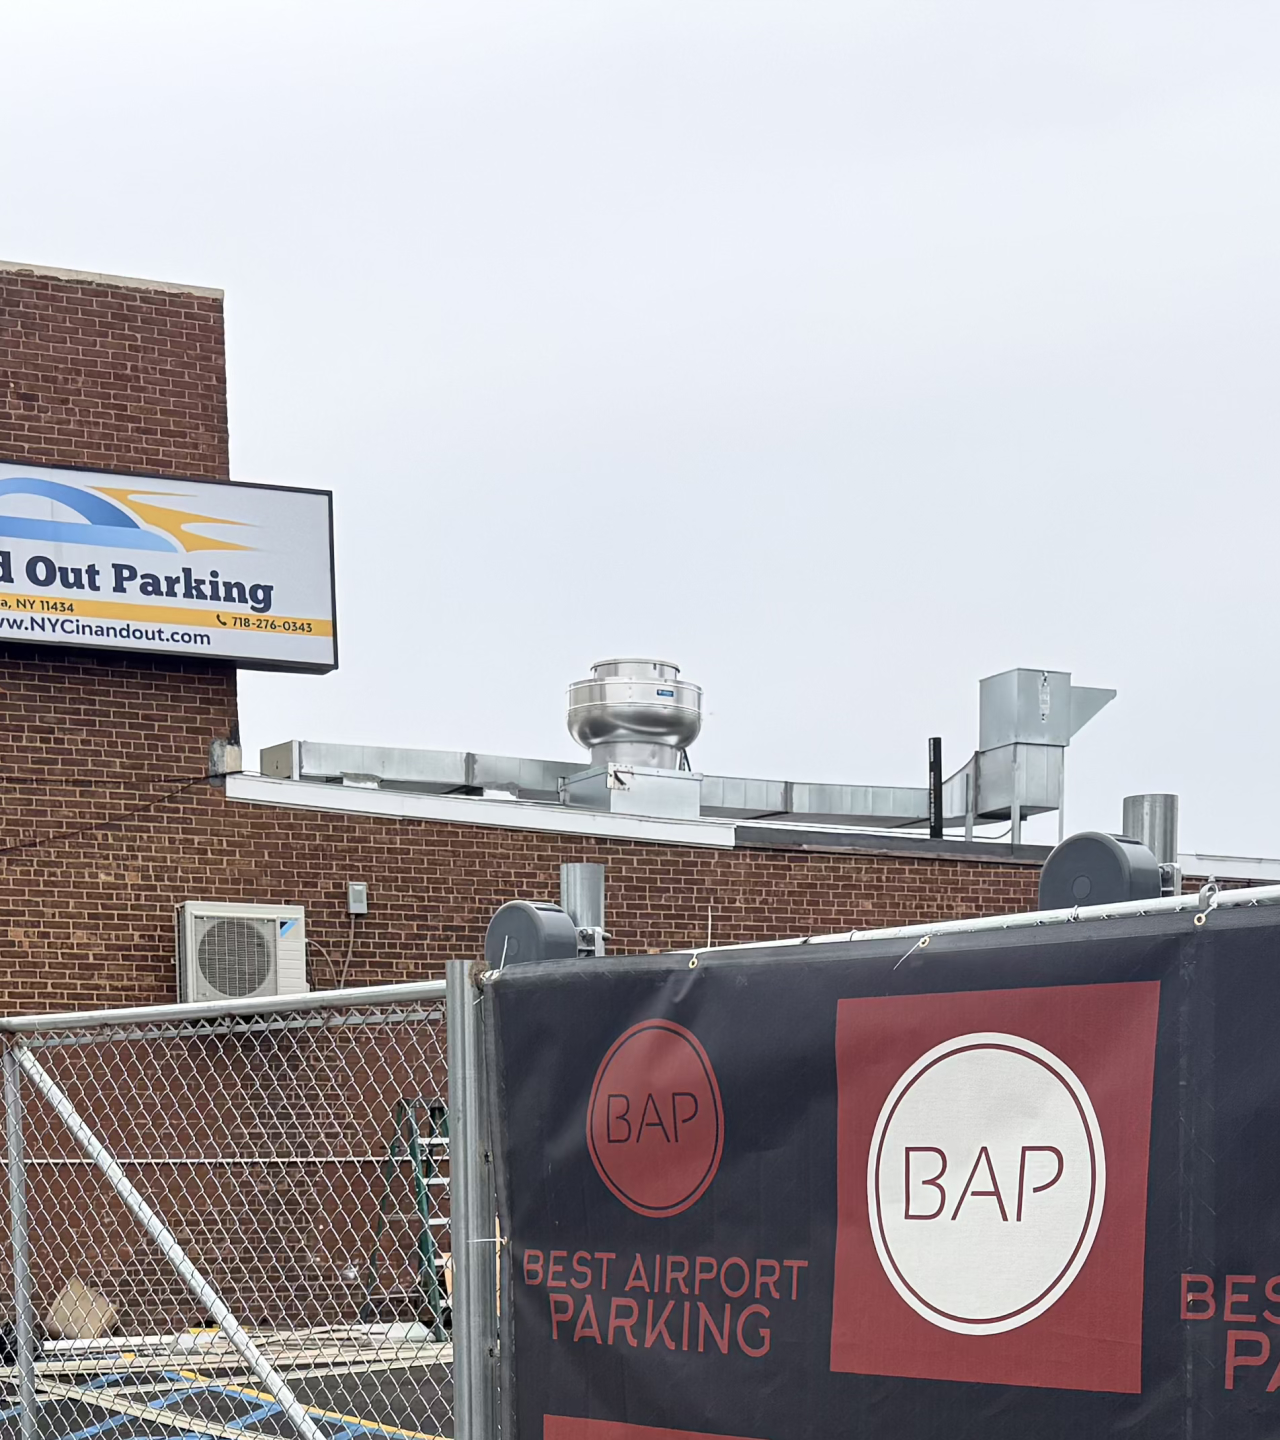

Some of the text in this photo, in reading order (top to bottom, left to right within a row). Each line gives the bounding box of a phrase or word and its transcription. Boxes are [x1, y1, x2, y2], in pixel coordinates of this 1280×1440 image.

[16, 598, 35, 610] NY
[40, 600, 74, 613] 11434
[25, 555, 100, 592] Out
[112, 563, 274, 613] Parking
[231, 617, 312, 633] 718-276-0343
[607, 1092, 699, 1144] BAP
[904, 1145, 1065, 1223] BAP
[522, 1249, 809, 1301] BEST AIRPORT
[550, 1294, 772, 1358] PARKING
